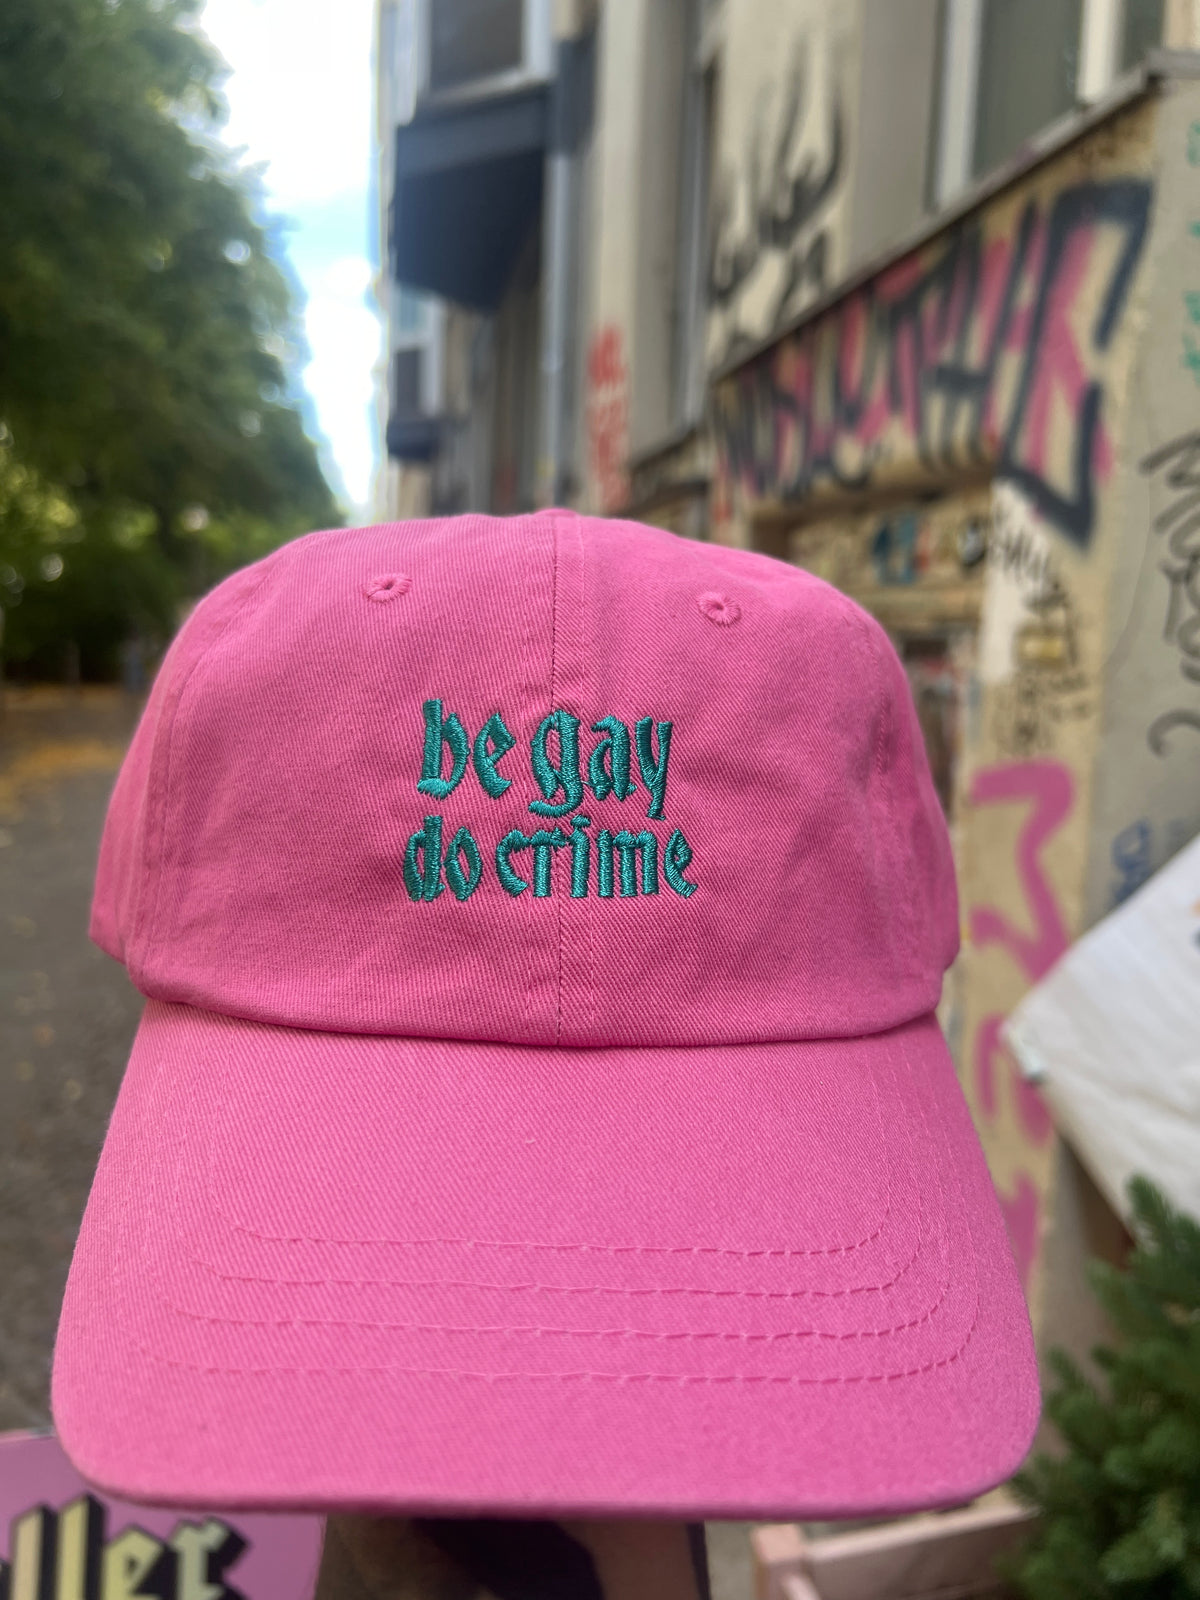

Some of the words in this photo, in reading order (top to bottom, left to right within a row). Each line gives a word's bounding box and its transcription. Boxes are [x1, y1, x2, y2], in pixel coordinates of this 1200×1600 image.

[416, 698, 517, 800] be
[528, 708, 674, 821] gay
[402, 815, 484, 902] do
[495, 813, 699, 899] crime
